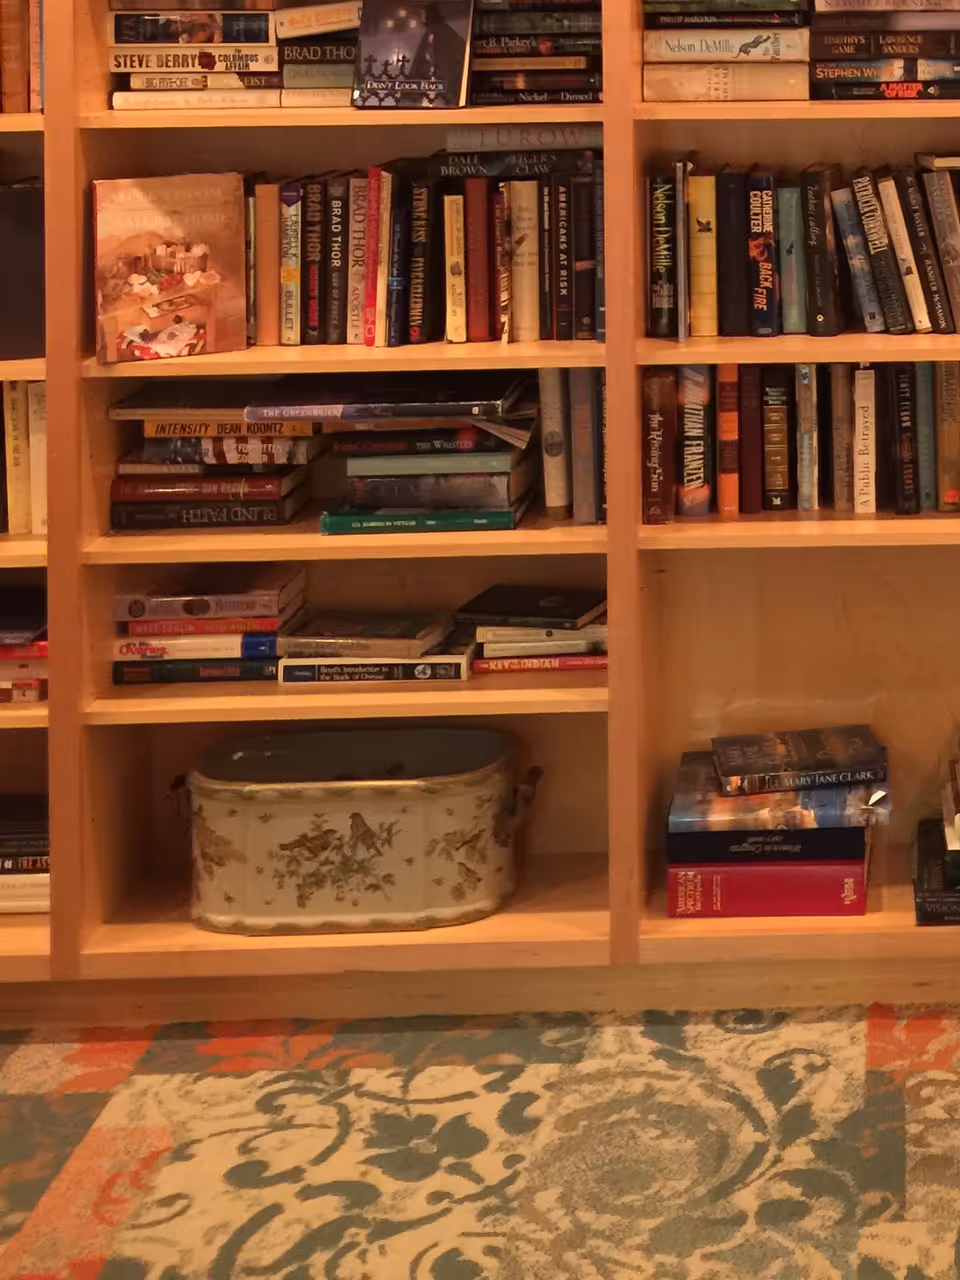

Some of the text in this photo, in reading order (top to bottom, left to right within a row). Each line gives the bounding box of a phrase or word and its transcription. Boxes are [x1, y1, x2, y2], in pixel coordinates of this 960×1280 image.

[665, 39, 735, 54] Nelson DeMille
[823, 35, 865, 46] TIMOTHY'S
[879, 34, 923, 45] LAWRENCE
[831, 46, 856, 54] GAME
[882, 44, 920, 54] SANDERS
[113, 53, 196, 69] STEVE BERRY
[218, 53, 259, 63] COLUMBUS
[225, 62, 251, 71] AFFAIR
[816, 66, 861, 78] STEPHEN
[395, 80, 419, 90] LOOK
[420, 81, 444, 90] BACK
[519, 91, 592, 101] Nickel Dimed
[440, 166, 488, 175] BROWN
[750, 191, 761, 232] COULTER
[763, 190, 773, 232] CATHERINE
[852, 176, 888, 255] PATRICIA CORNWELL
[653, 184, 672, 272] Nelson DeMille
[558, 186, 567, 296] AMERICANS AT RISK
[350, 185, 367, 328] BRAD THOR APOSTLE
[410, 187, 428, 326] STONE KISS FAYE KELLERMAN
[908, 187, 946, 329] NIGHT SISTER JENNIFER McMAHON
[759, 261, 772, 288] BACK
[754, 288, 766, 310] FIRE
[284, 291, 294, 330] BULLET
[155, 423, 284, 435] INTENSITY DEAN KOONTZ
[683, 381, 704, 490] JONATHAN FRANZEN
[647, 413, 663, 492] the Rising Sun
[183, 507, 277, 523] BLIND FAITH
[489, 659, 559, 671] KEY INDIAN
[784, 771, 873, 787] MARY JANE CLARK
